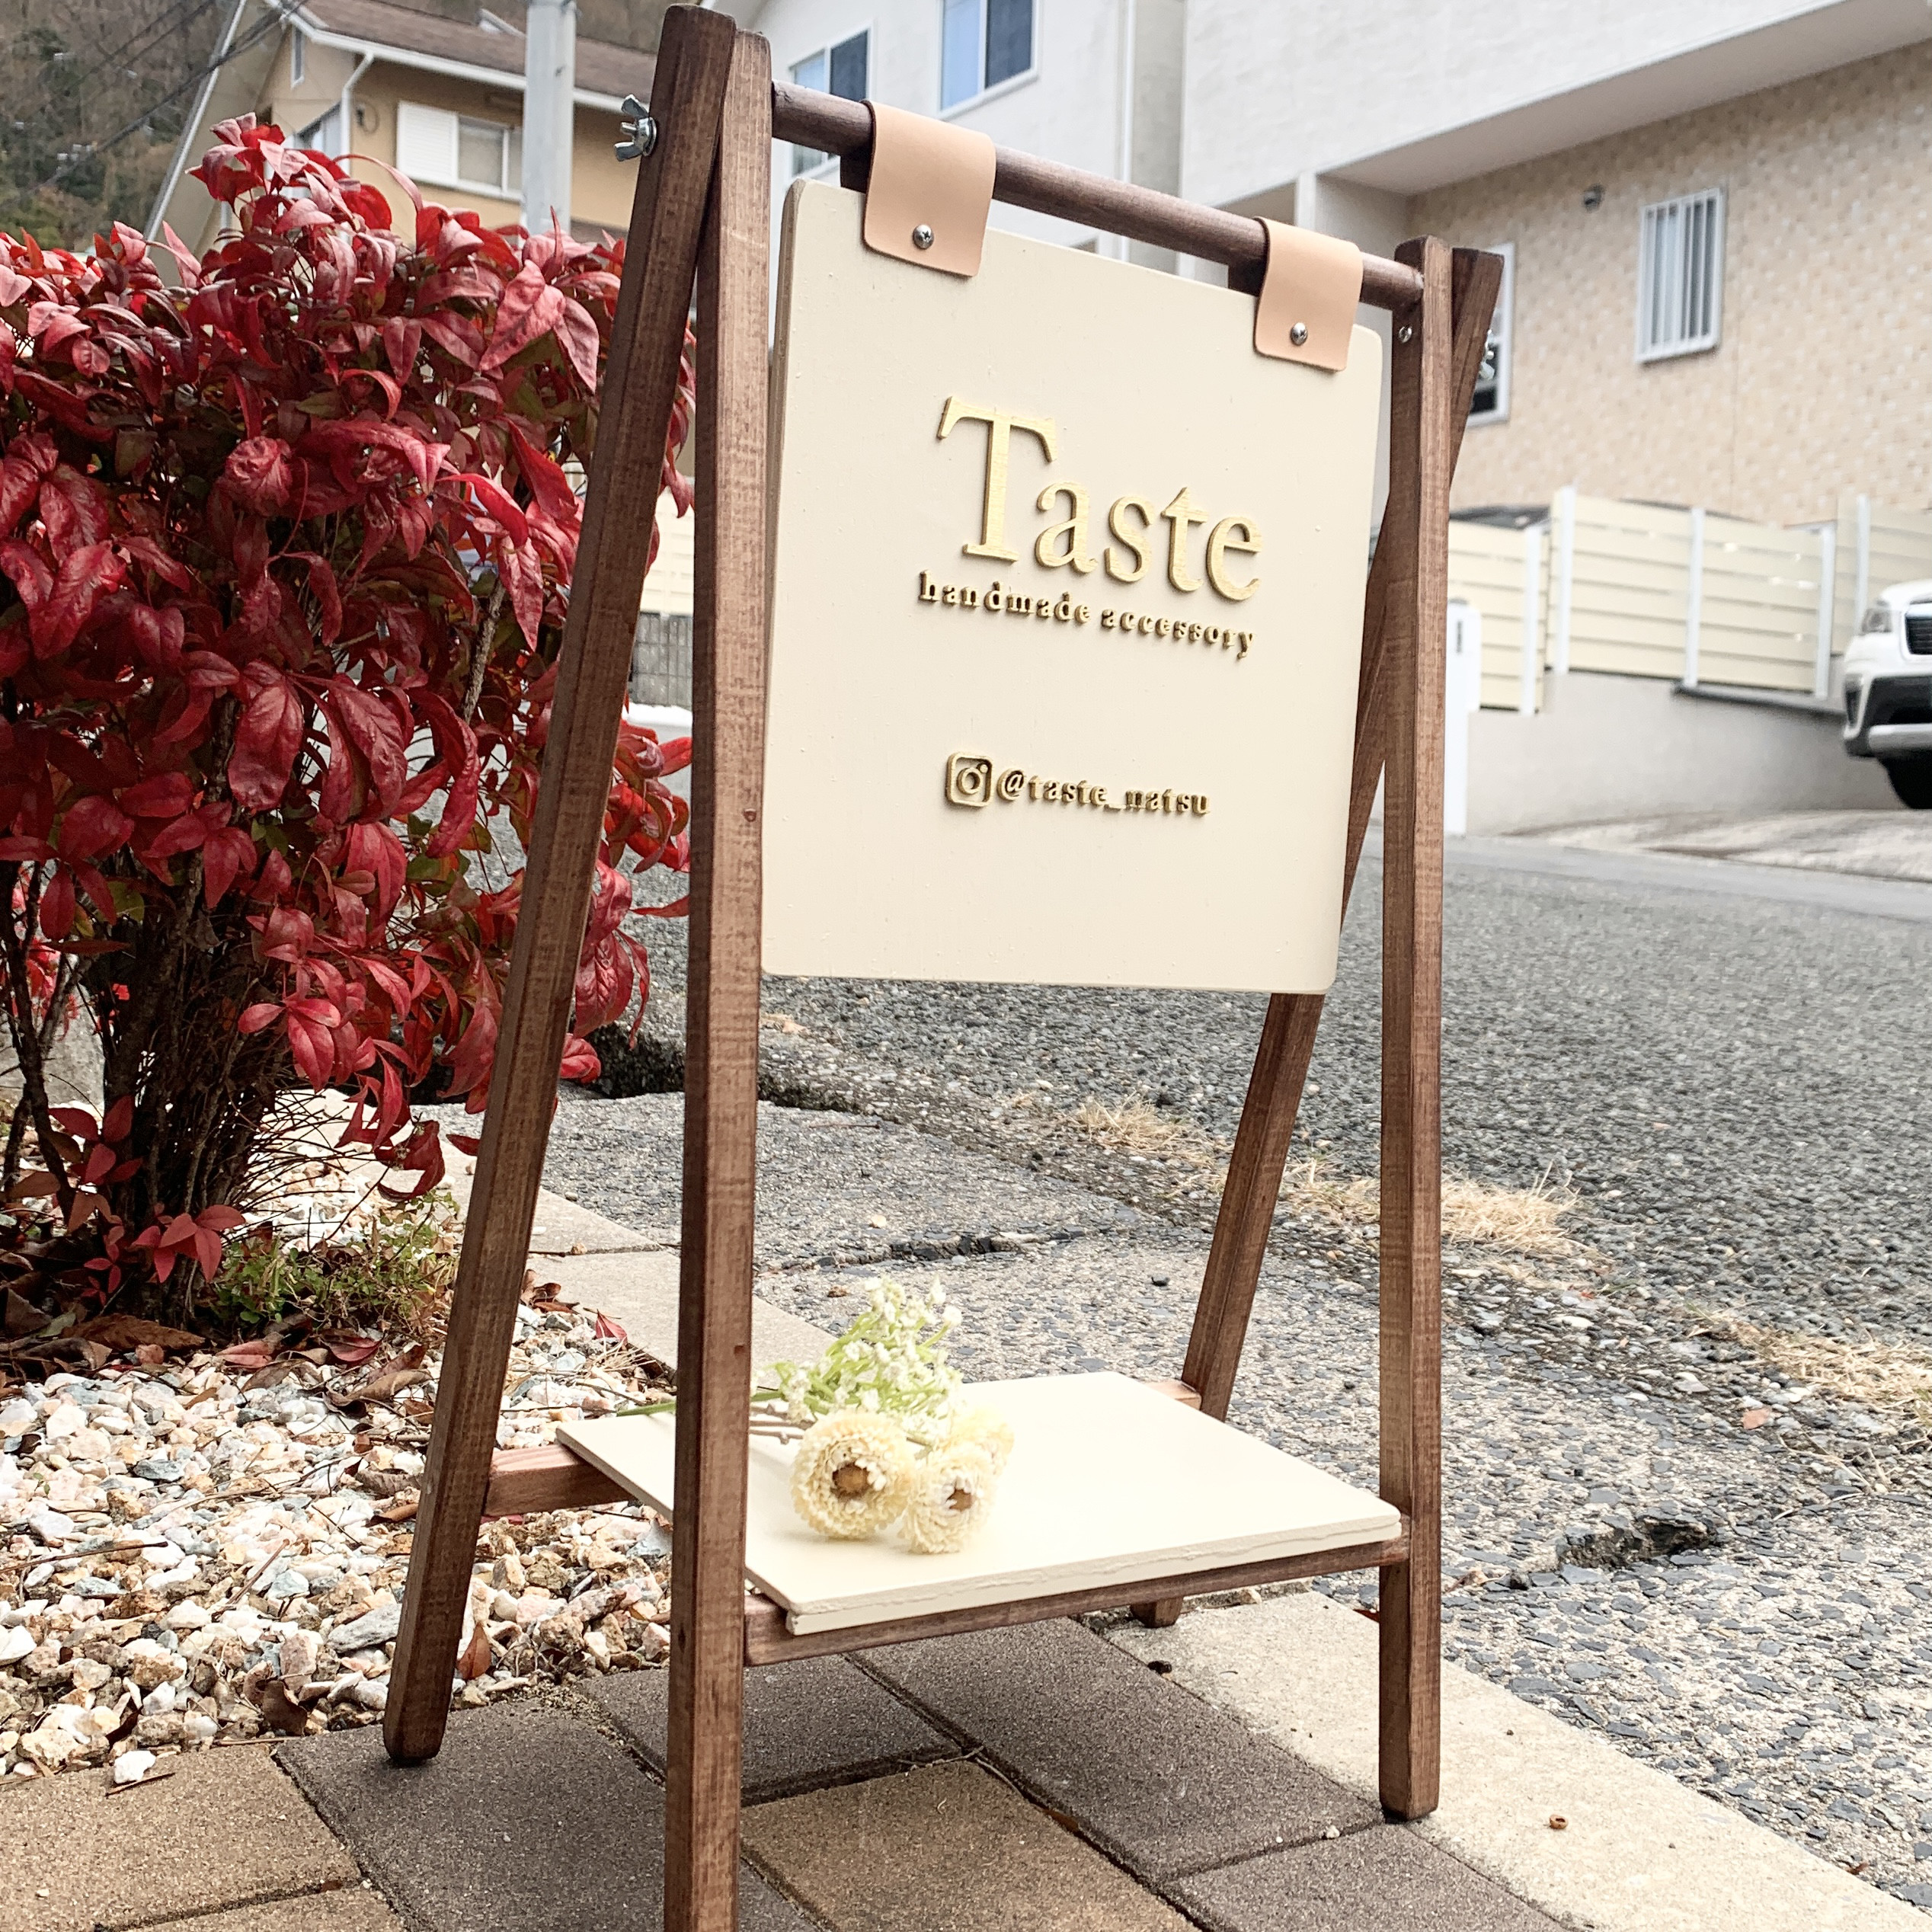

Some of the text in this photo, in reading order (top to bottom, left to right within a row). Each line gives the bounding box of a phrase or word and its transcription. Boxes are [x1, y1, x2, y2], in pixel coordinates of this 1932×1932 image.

[936, 395, 1262, 600] Taste
[919, 569, 1257, 661] handmade accessory
[996, 768, 1211, 814] @taste_natsu
